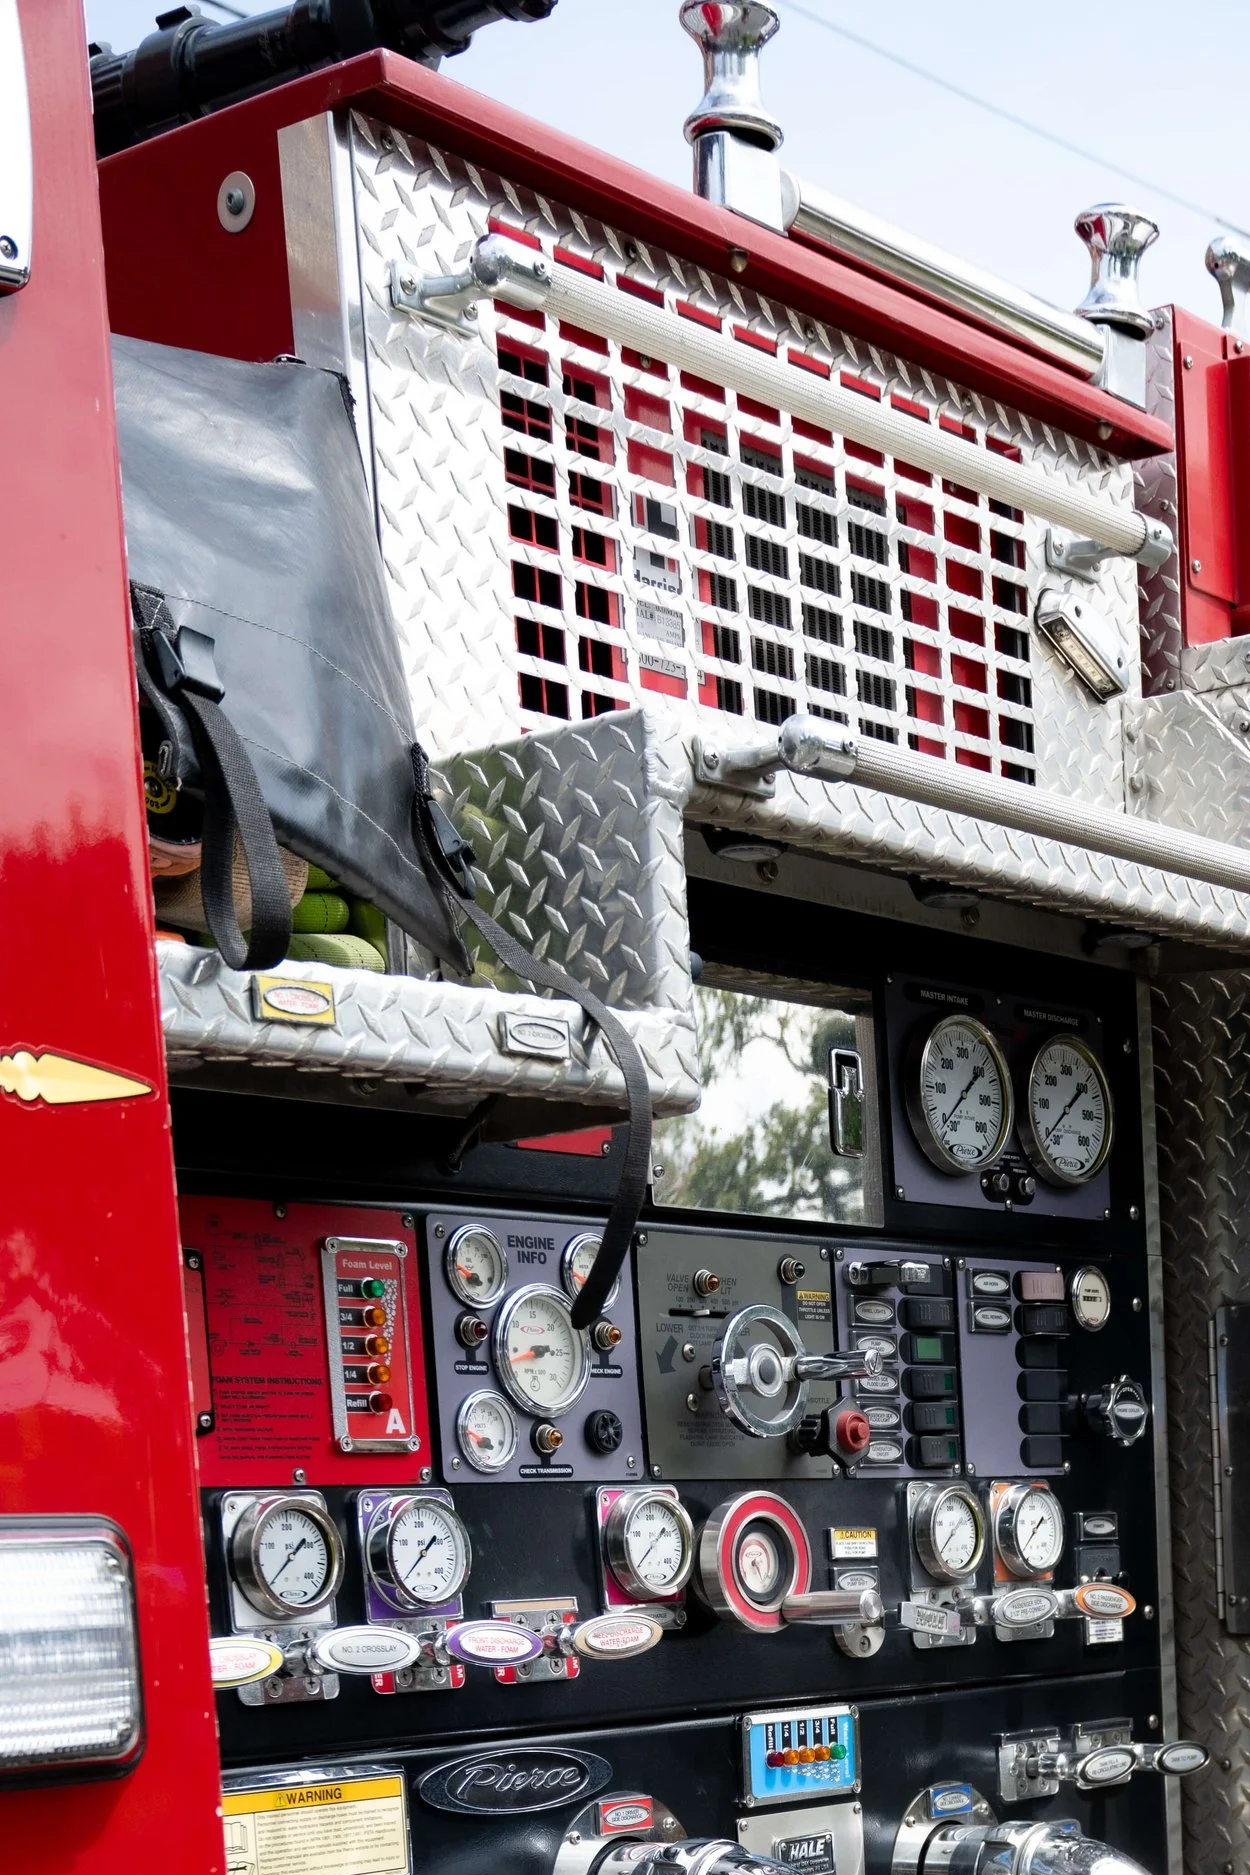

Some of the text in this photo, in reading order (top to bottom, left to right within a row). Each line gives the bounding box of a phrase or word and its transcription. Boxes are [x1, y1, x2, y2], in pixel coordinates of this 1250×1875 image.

[920, 989, 969, 1006] MASTER INTAKE
[1023, 1009, 1079, 1026] MASTER DISCHARGE
[956, 1047, 969, 1059] 300
[941, 1057, 954, 1070] 200
[972, 1065, 985, 1078] 400
[1060, 1064, 1073, 1077] 300
[1045, 1075, 1057, 1087] 200
[935, 1082, 946, 1094] 100
[1076, 1082, 1088, 1094] 400
[979, 1094, 991, 1107] 500
[1038, 1098, 1049, 1110] 100
[1082, 1110, 1094, 1121] 500
[975, 1122, 988, 1133] 600
[1078, 1136, 1090, 1147] 600
[955, 1144, 976, 1157] Pierce
[507, 1234, 556, 1250] ENGINE
[517, 1251, 547, 1265] INFO
[342, 1259, 392, 1271] Foam Level
[666, 1274, 737, 1286] VALVE HEN
[338, 1284, 353, 1293] Full
[667, 1284, 732, 1295] OPEN LIT
[340, 1313, 353, 1322] 3/4
[529, 1310, 537, 1319] 15
[512, 1320, 520, 1328] 10
[547, 1323, 555, 1332] 20
[656, 1323, 684, 1334] LOWER
[342, 1341, 355, 1350] 1/2
[555, 1348, 563, 1356] 25
[344, 1370, 357, 1379] 1/4
[235, 1376, 265, 1385] SYSTEM
[267, 1377, 323, 1386] INSTRUCTIONS
[346, 1399, 368, 1408] Refill
[385, 1408, 407, 1434] A
[281, 1523, 292, 1531] 200
[414, 1521, 424, 1529] 200
[845, 1530, 872, 1538] CAUTION
[265, 1542, 275, 1550] 100
[285, 1542, 295, 1551] psi
[398, 1539, 408, 1547] 100
[417, 1538, 426, 1547] psi
[663, 1557, 672, 1565] 400
[304, 1572, 314, 1581] 400
[434, 1567, 444, 1575] 400
[468, 1636, 525, 1646] FRONT DISCHARGE
[342, 1644, 398, 1653] NO. 2 CROSSLAY
[456, 1763, 581, 1800] Pierce
[286, 1788, 342, 1804] WARNING
[789, 1839, 826, 1861] HALE
